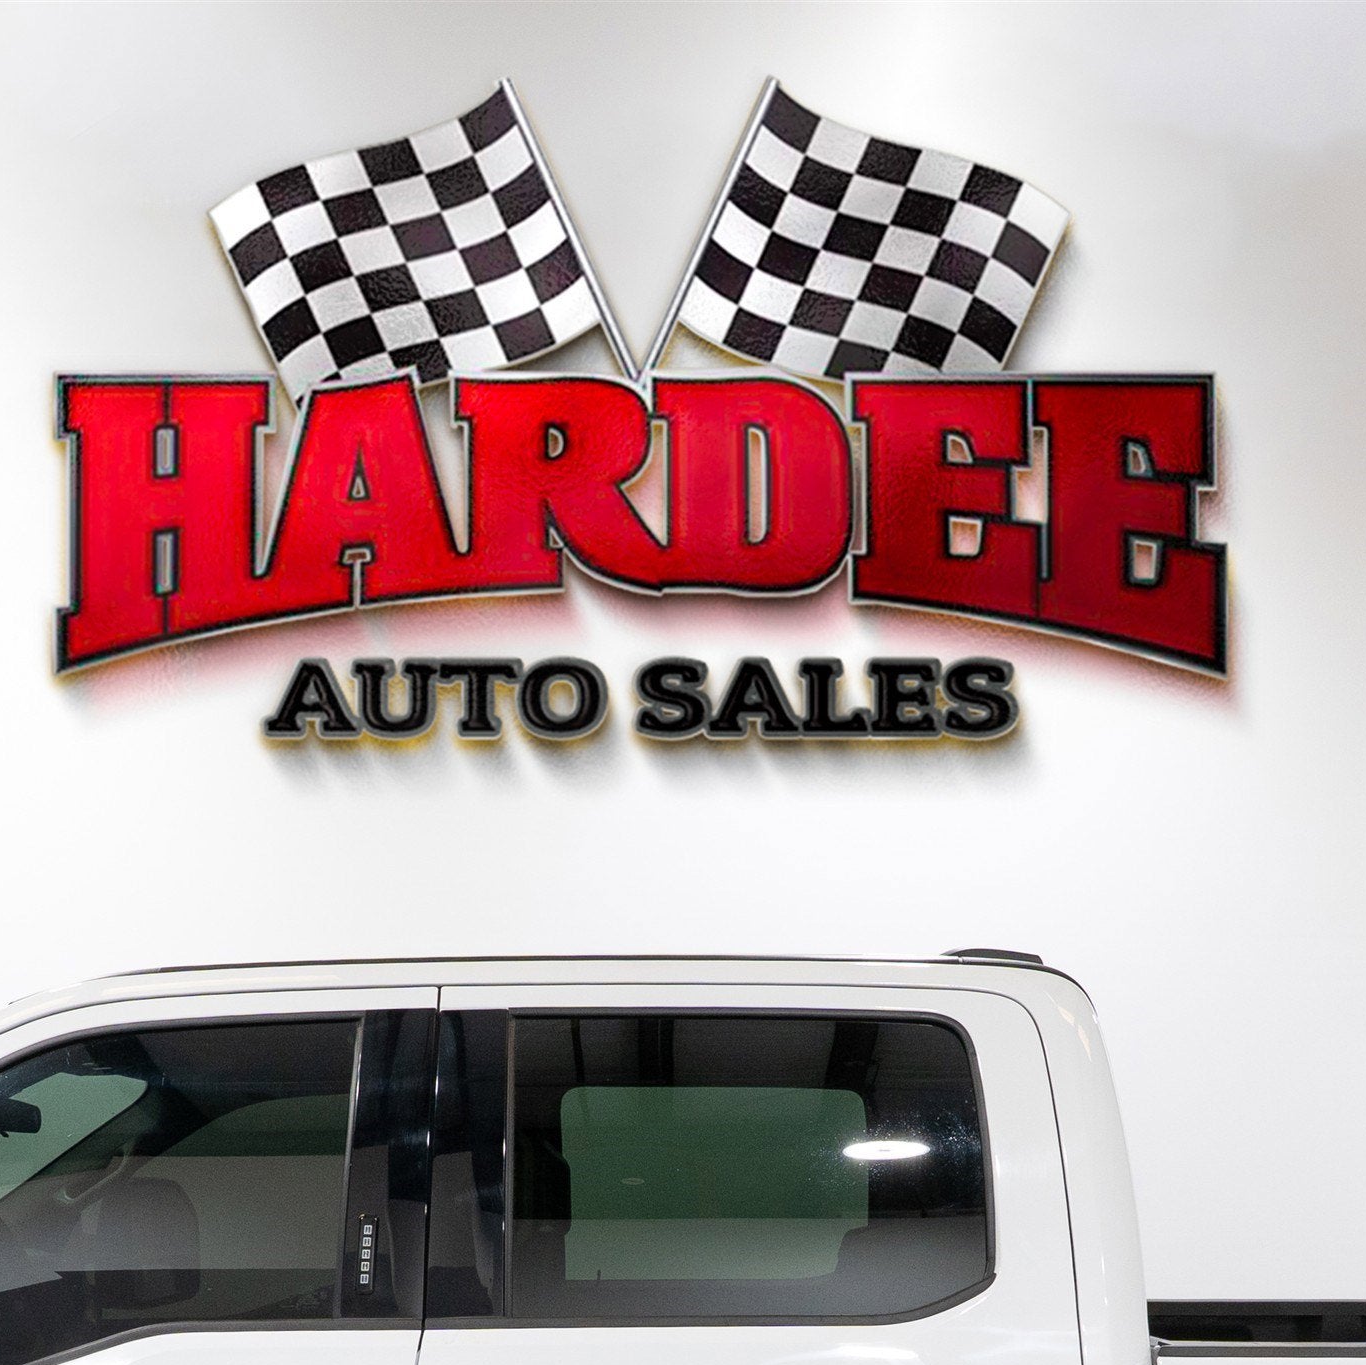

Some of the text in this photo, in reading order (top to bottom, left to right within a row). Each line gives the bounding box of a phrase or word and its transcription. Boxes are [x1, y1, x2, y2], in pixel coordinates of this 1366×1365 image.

[54, 371, 1232, 677] HARDEE
[265, 657, 1020, 740] AUTO SALES
